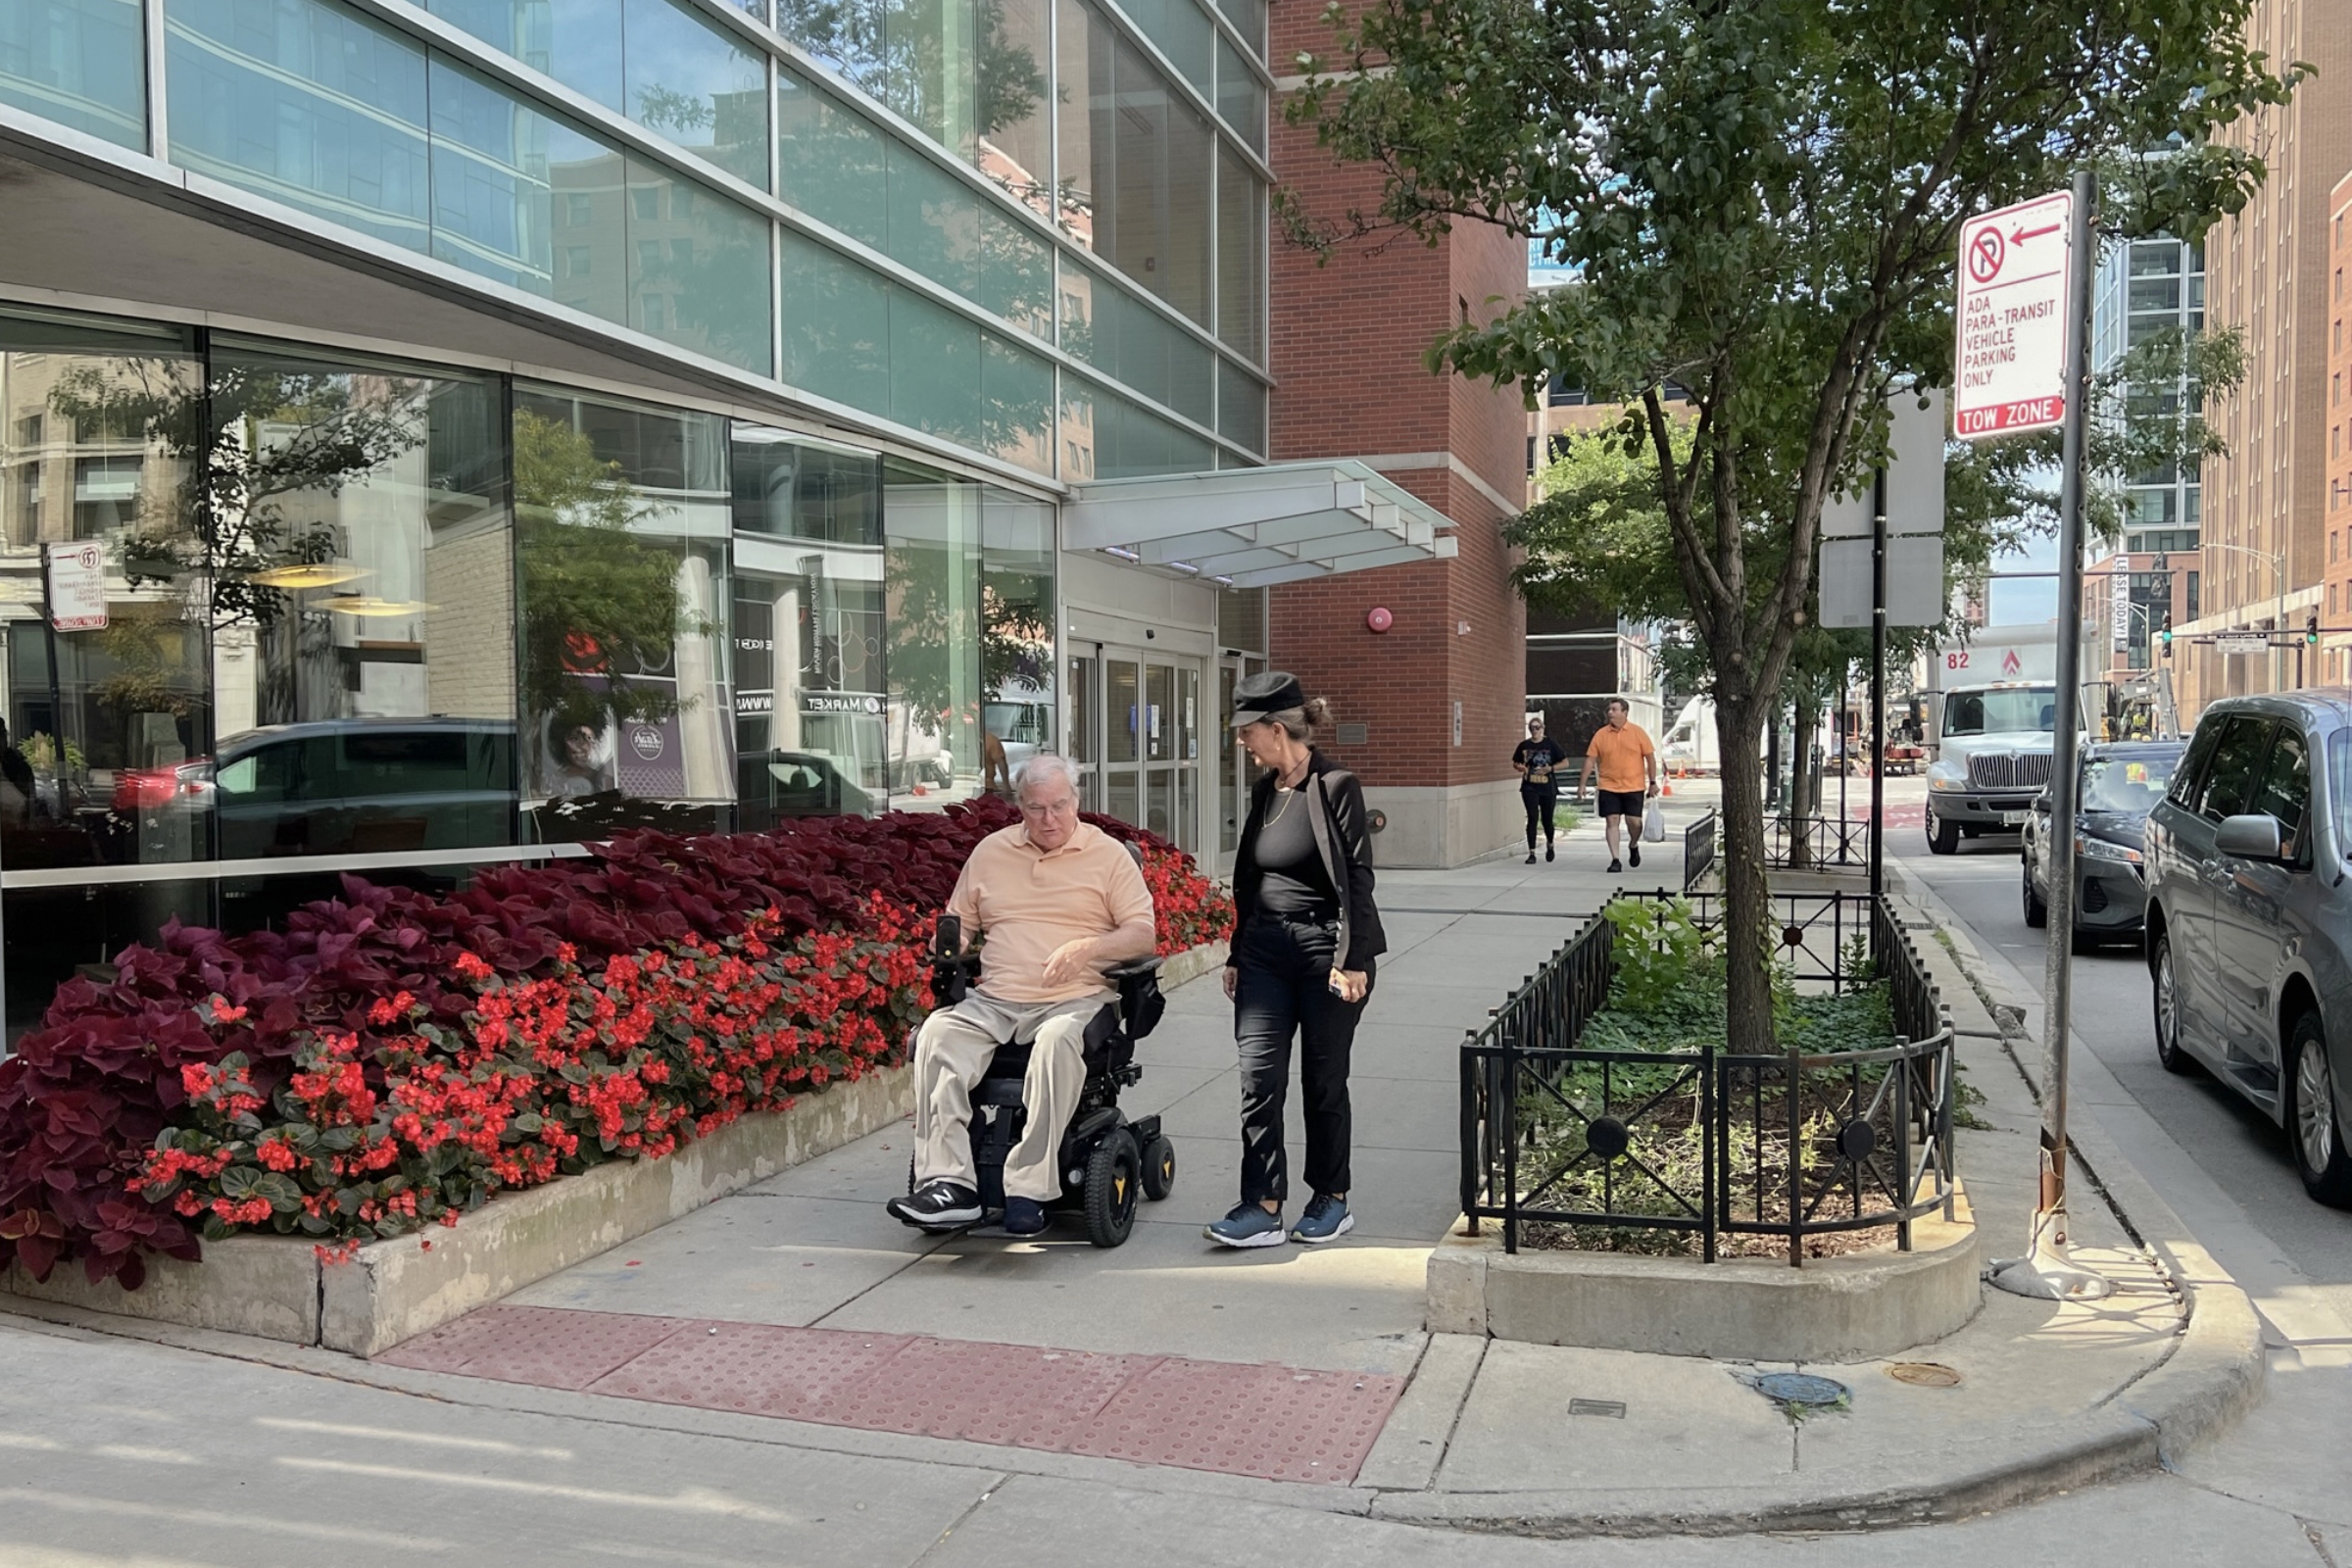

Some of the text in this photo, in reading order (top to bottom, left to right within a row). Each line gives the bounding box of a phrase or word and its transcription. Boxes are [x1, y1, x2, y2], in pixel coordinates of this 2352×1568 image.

[1966, 299, 2055, 334] PARA-TRANSIT
[1967, 296, 1990, 315] ADA
[1966, 327, 2015, 351] VEHICLE
[1964, 346, 2016, 370] PARKING
[1964, 368, 1993, 388] ONLY
[1963, 399, 2054, 433] TOW ZONE
[2117, 597, 2128, 635] TODAY!
[1947, 653, 1969, 669] 82
